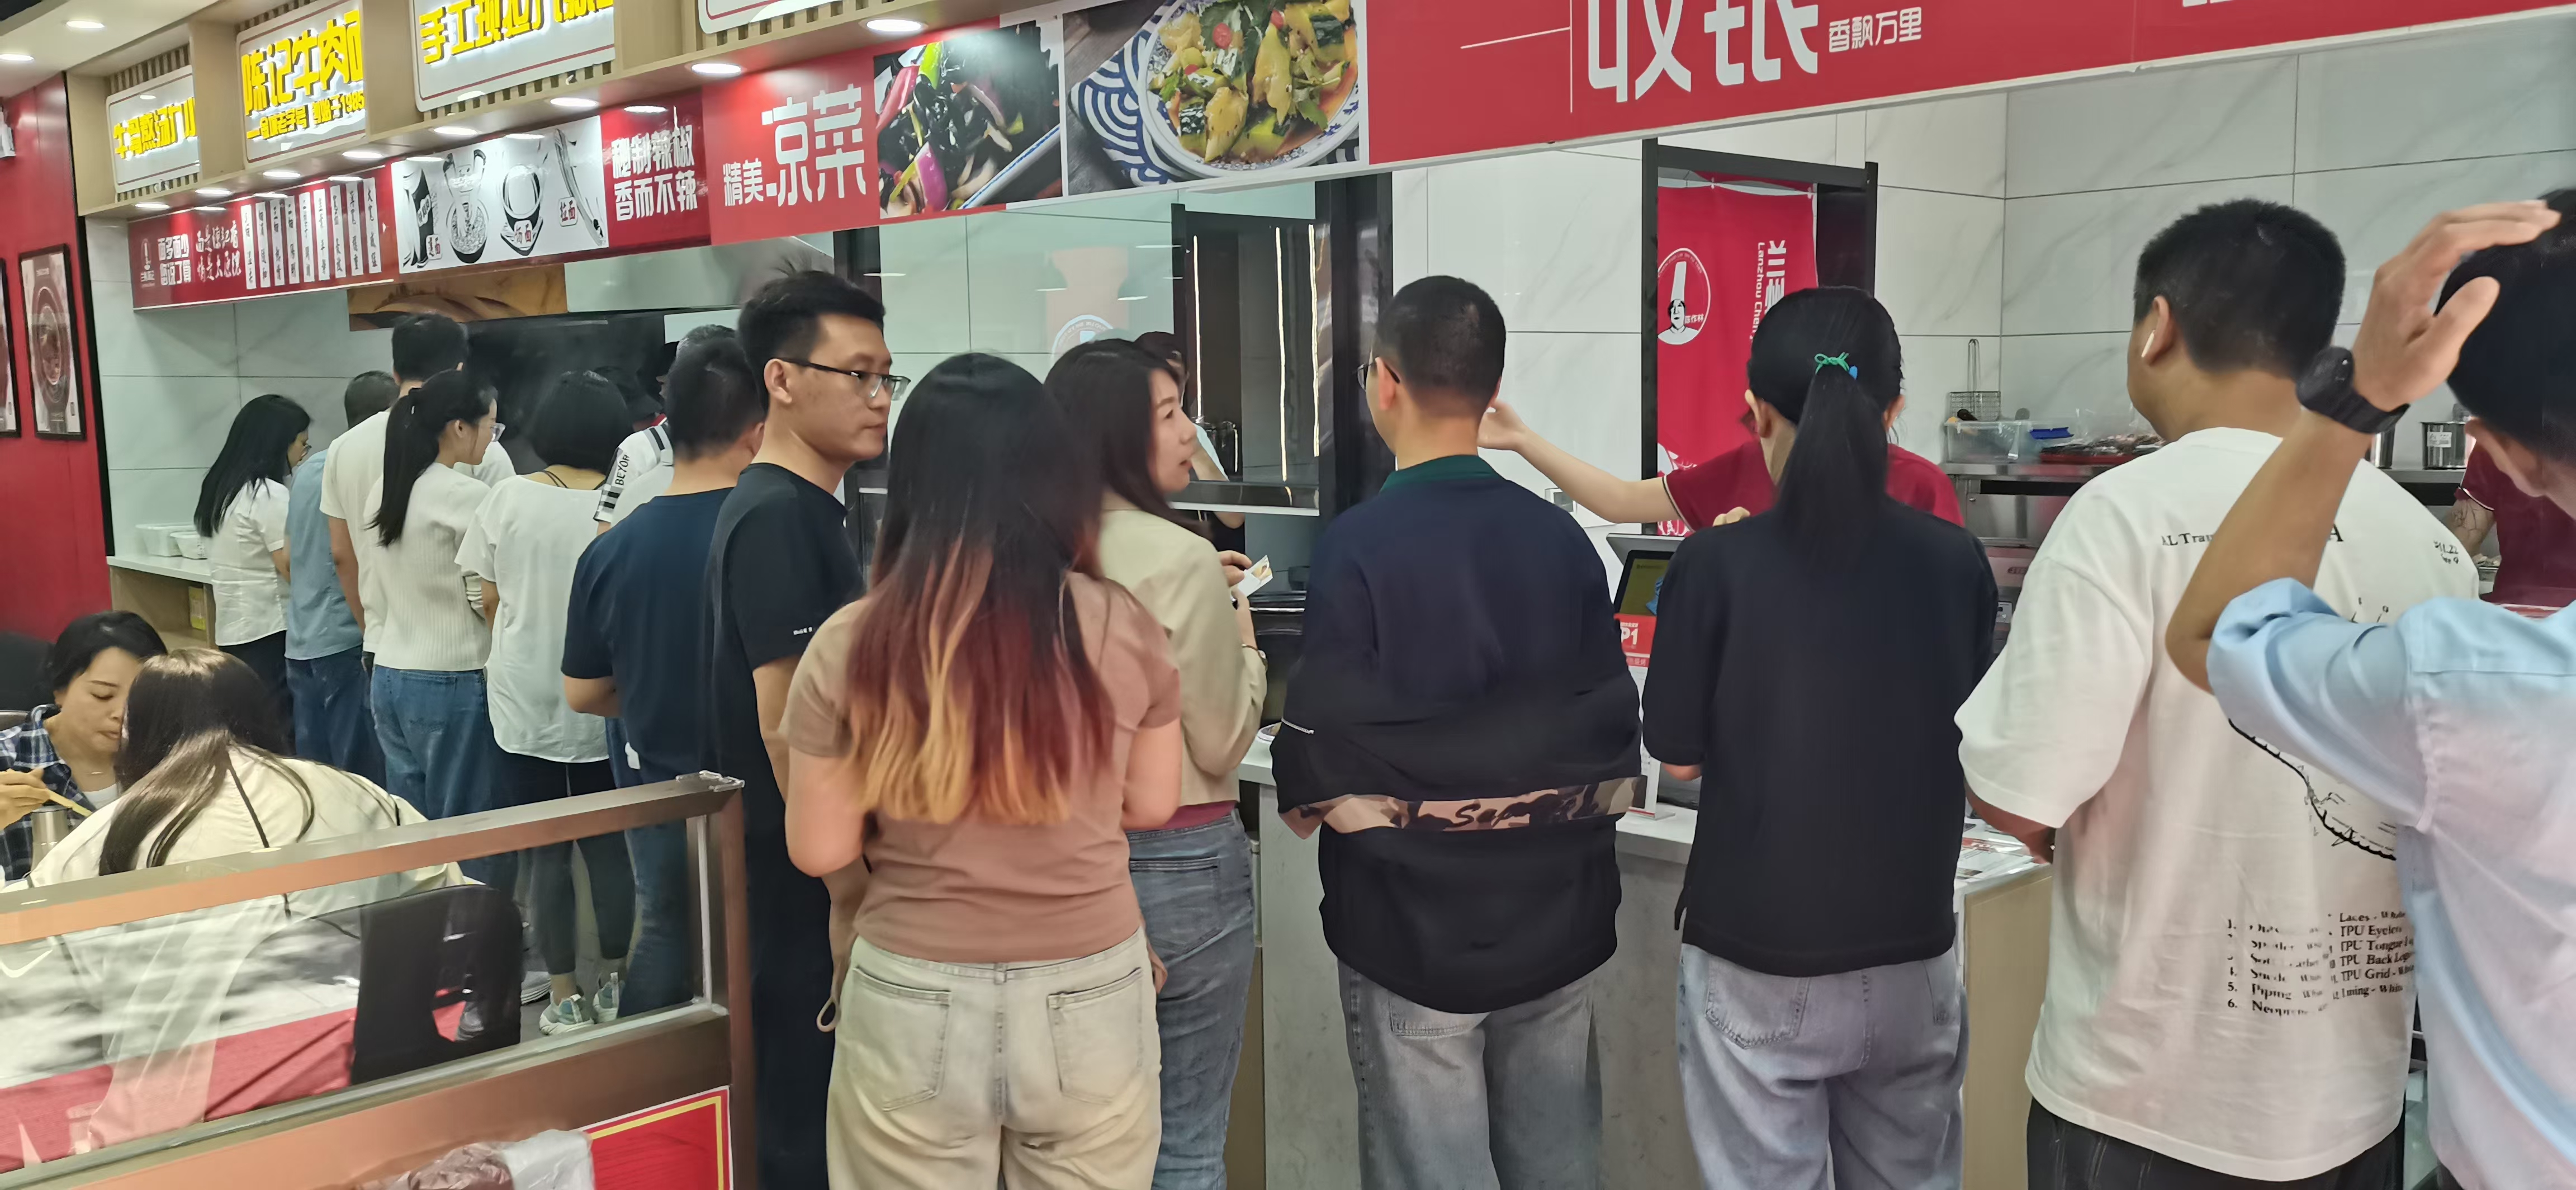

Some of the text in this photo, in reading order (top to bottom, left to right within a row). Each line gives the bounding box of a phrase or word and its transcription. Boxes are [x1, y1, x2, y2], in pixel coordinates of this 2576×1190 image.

[1829, 7, 1922, 53] 香飘万里
[614, 170, 698, 221] 香而不辣
[158, 234, 190, 261] 面多面少
[160, 259, 191, 286] 你说了算
[1756, 242, 1765, 298] Lanzhou
[2341, 925, 2365, 937] TPU
[2366, 953, 2392, 965] Back
[2341, 968, 2362, 981] TPU
[2365, 967, 2390, 979] Grid
